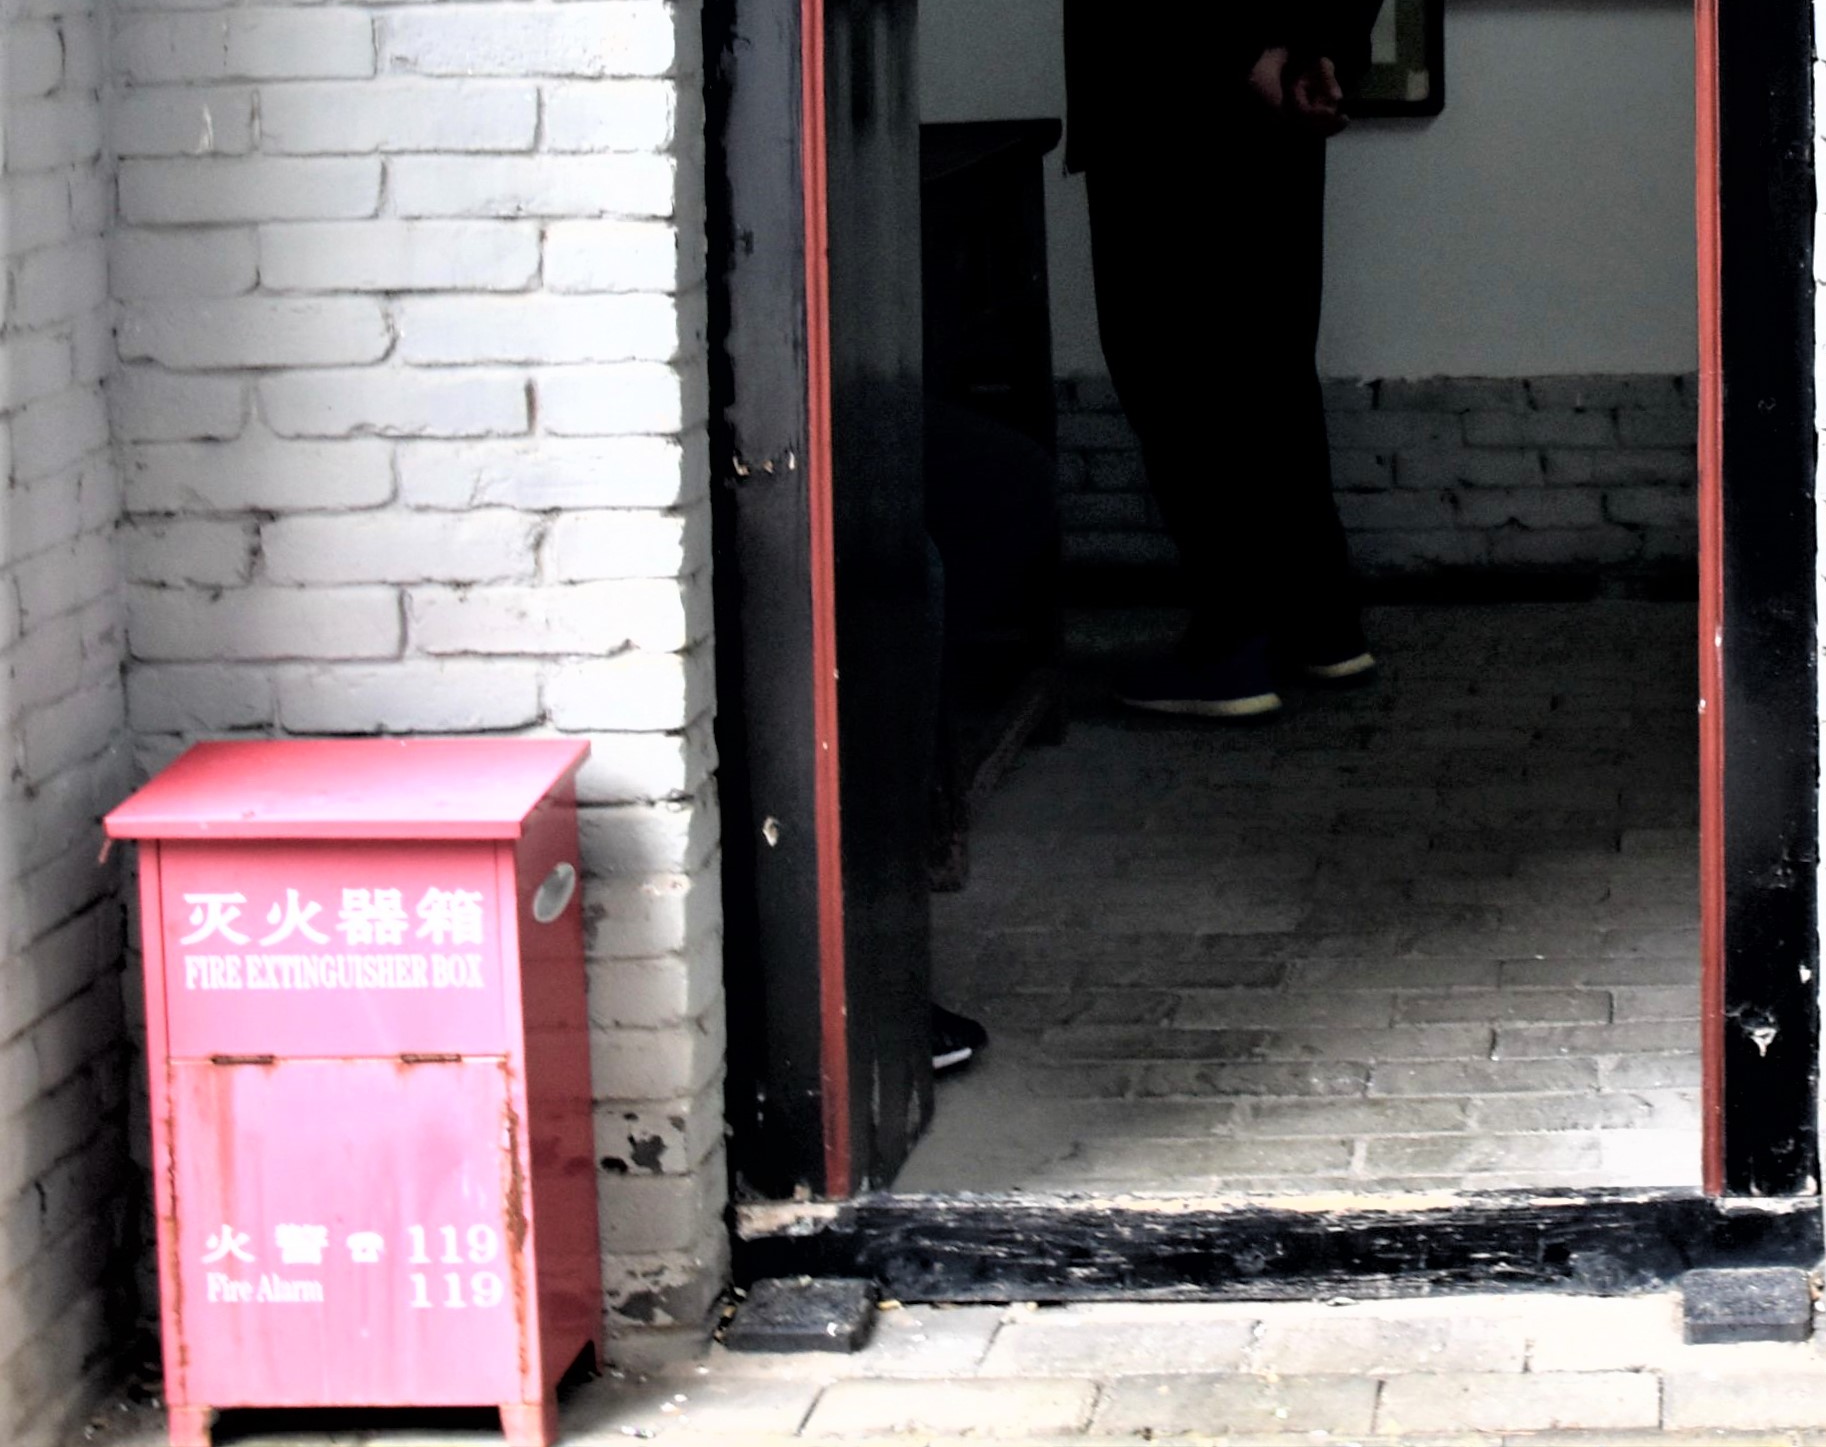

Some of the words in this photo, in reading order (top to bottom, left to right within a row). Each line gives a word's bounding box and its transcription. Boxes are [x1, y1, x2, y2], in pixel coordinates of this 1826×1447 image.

[179, 886, 485, 947] 灭火器箱
[184, 954, 243, 990] FIRE
[246, 954, 429, 990] EXTINGUISHER
[432, 953, 486, 988] BOX
[407, 1223, 499, 1264] 119
[206, 1271, 254, 1302] Fire
[256, 1272, 325, 1302] Alarm
[409, 1270, 505, 1309] 119
